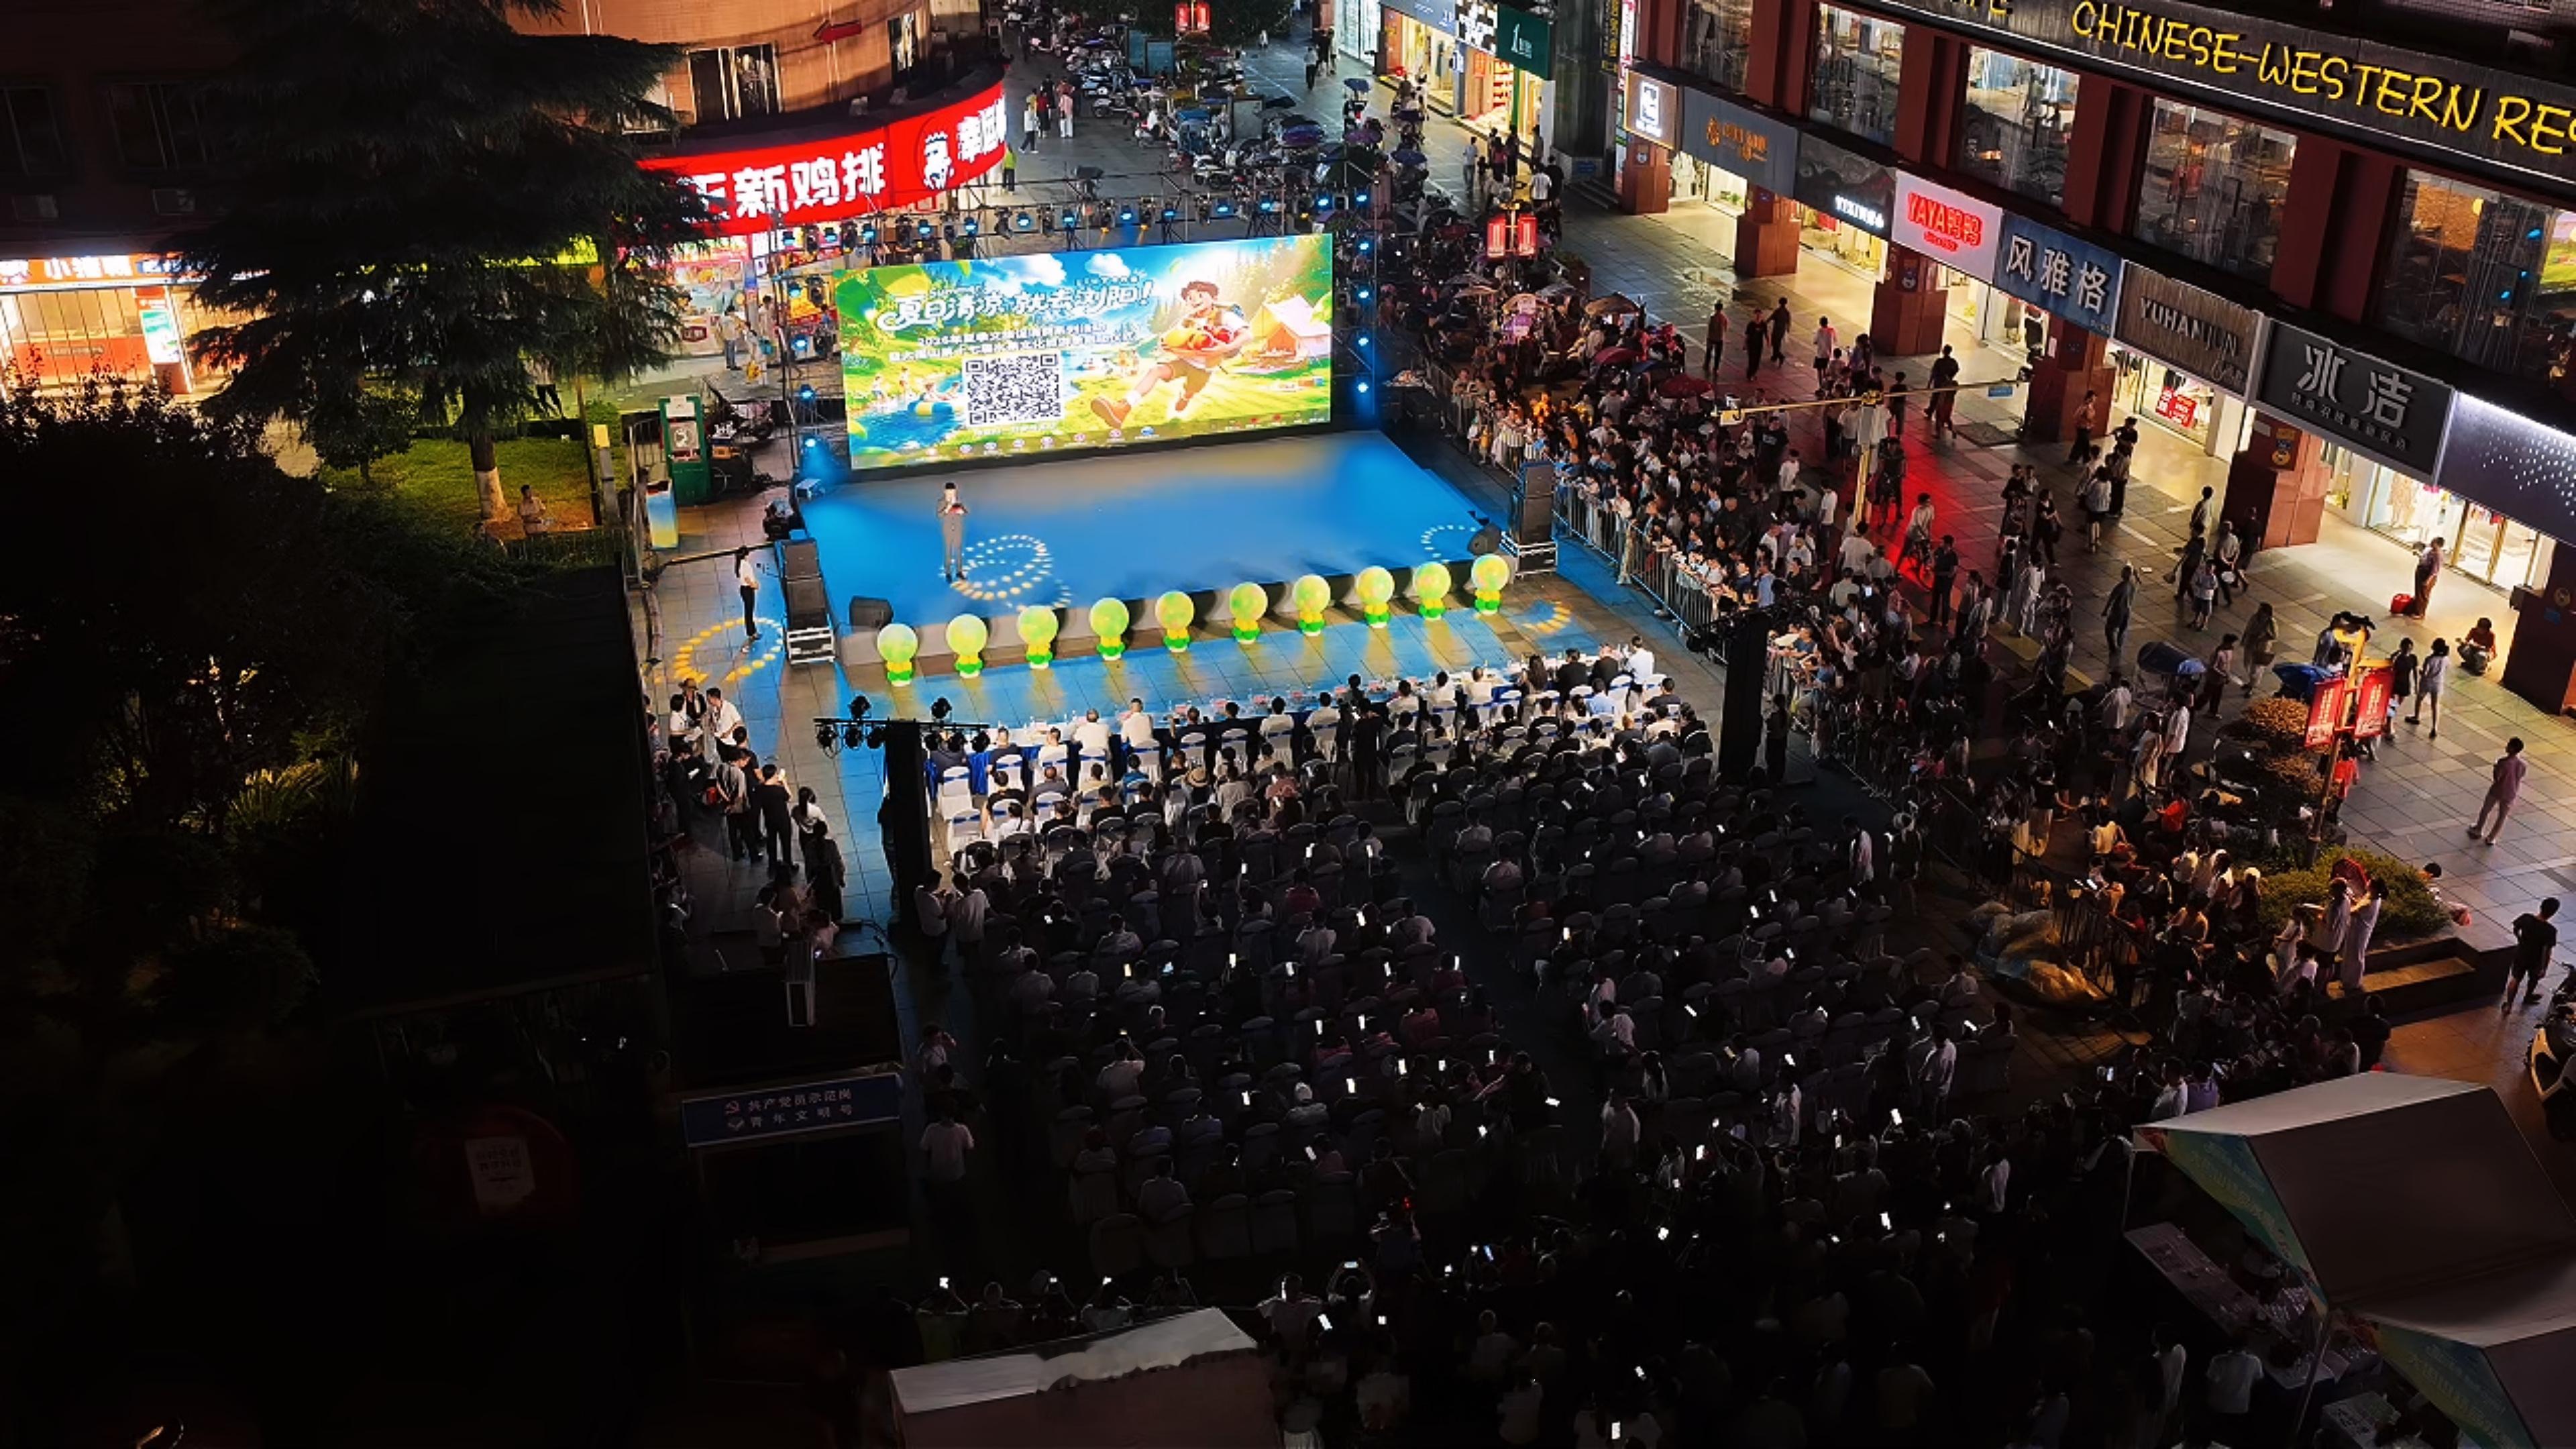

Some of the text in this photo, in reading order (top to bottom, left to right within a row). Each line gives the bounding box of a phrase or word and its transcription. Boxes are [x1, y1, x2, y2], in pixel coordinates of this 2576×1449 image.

[2072, 1, 2576, 155] CHINESE-WESTERN RE
[2006, 235, 2110, 315] 风雅格
[2297, 343, 2413, 429] 冰洁
[748, 1088, 852, 1112] 共产党员示范岗
[751, 1104, 853, 1128] 青年文明号
